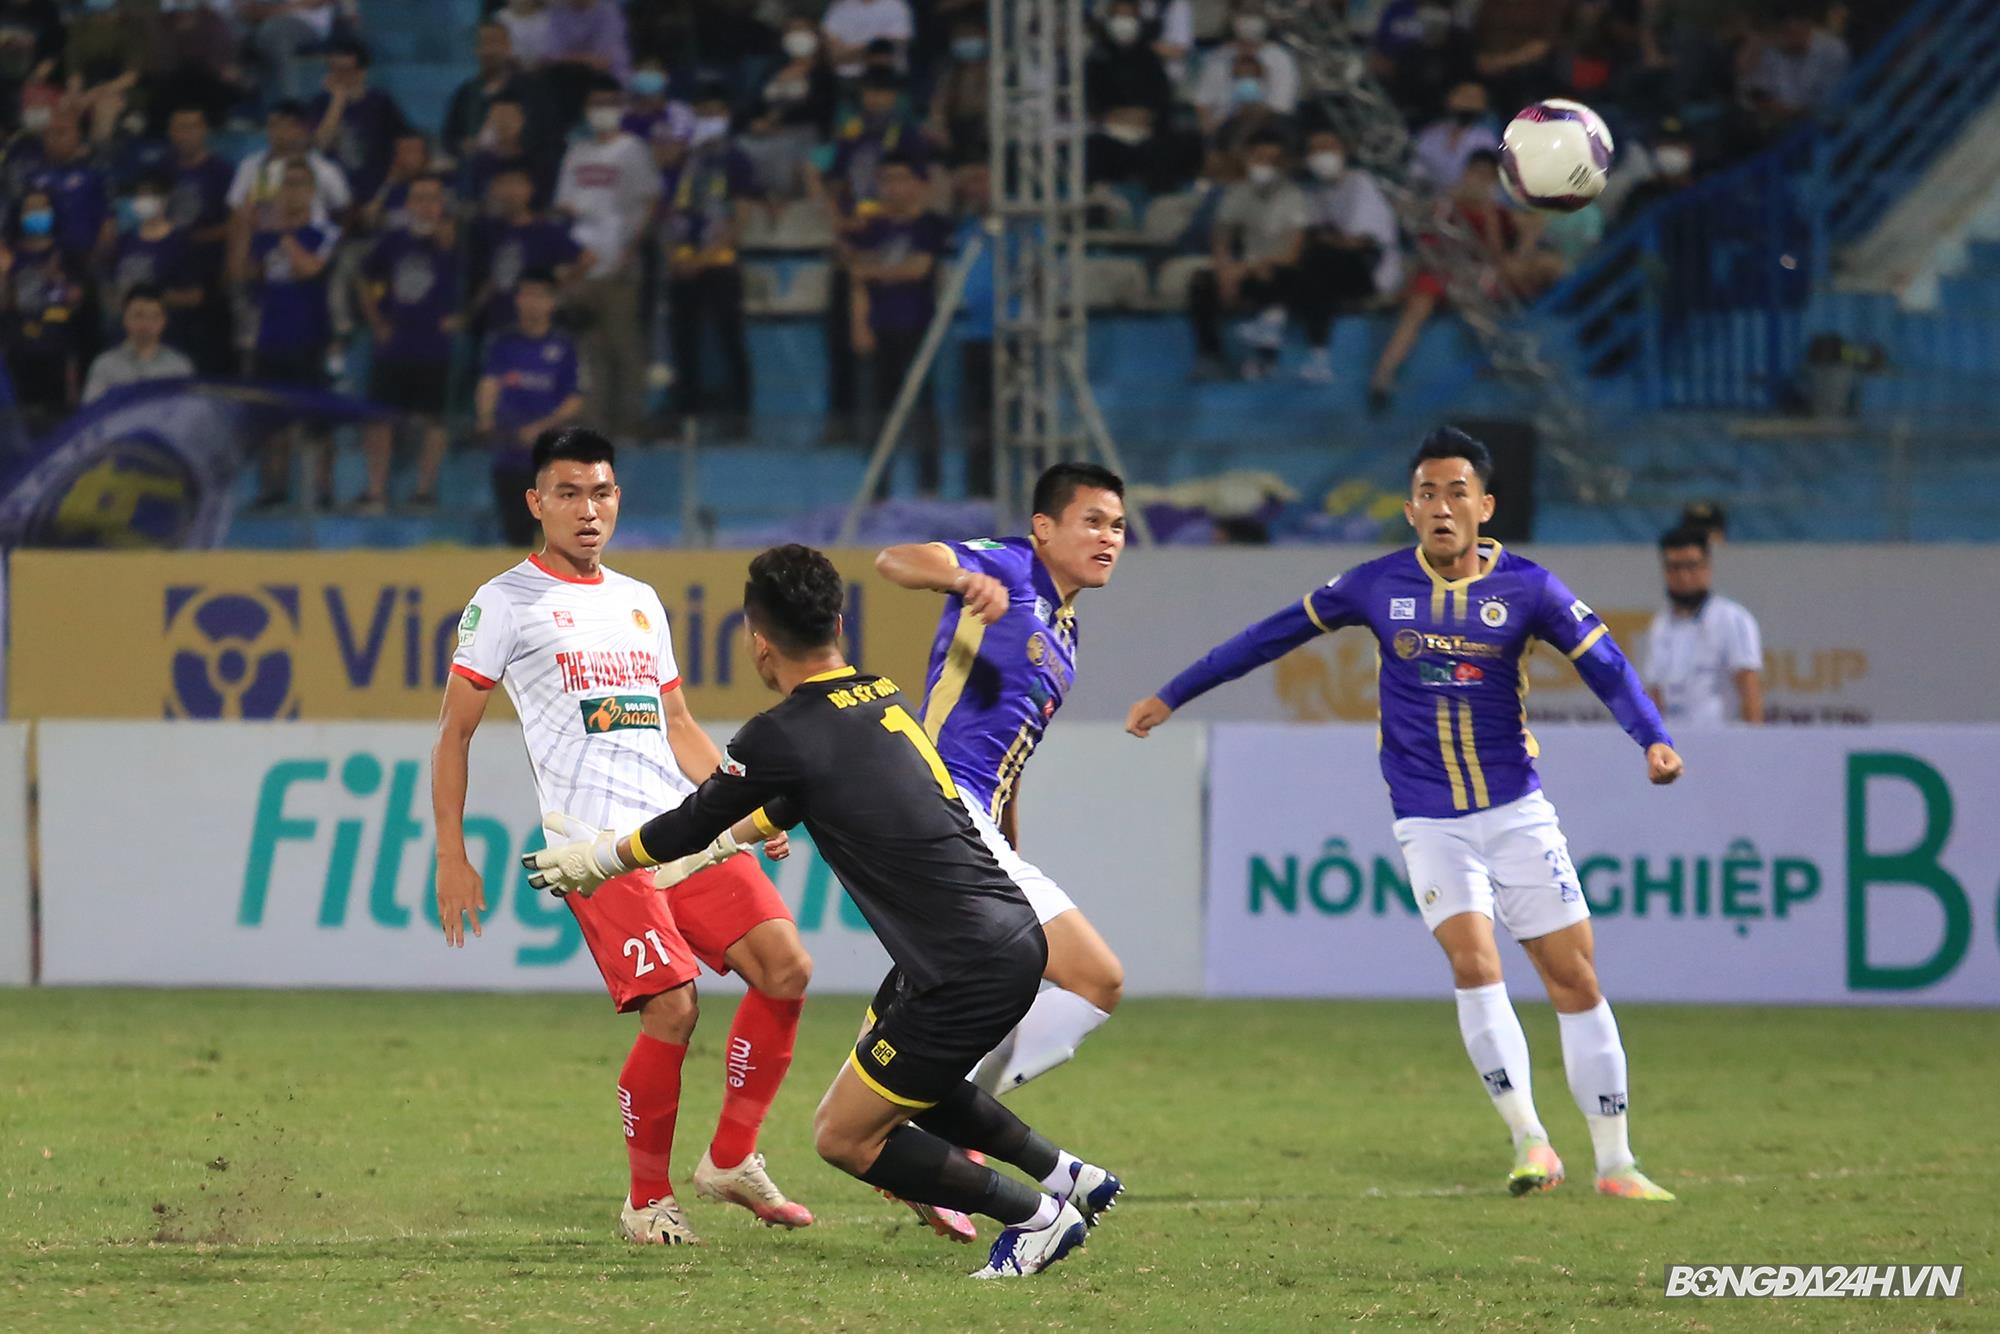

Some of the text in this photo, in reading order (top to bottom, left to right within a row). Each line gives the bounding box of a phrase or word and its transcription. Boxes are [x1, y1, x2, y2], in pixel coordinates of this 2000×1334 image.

[555, 651, 590, 694] THE
[880, 704, 959, 800] 1
[1583, 838, 1821, 936] GHIỆP
[623, 929, 671, 978] 21
[728, 1037, 757, 1088] mitre
[617, 1085, 640, 1137] mitre
